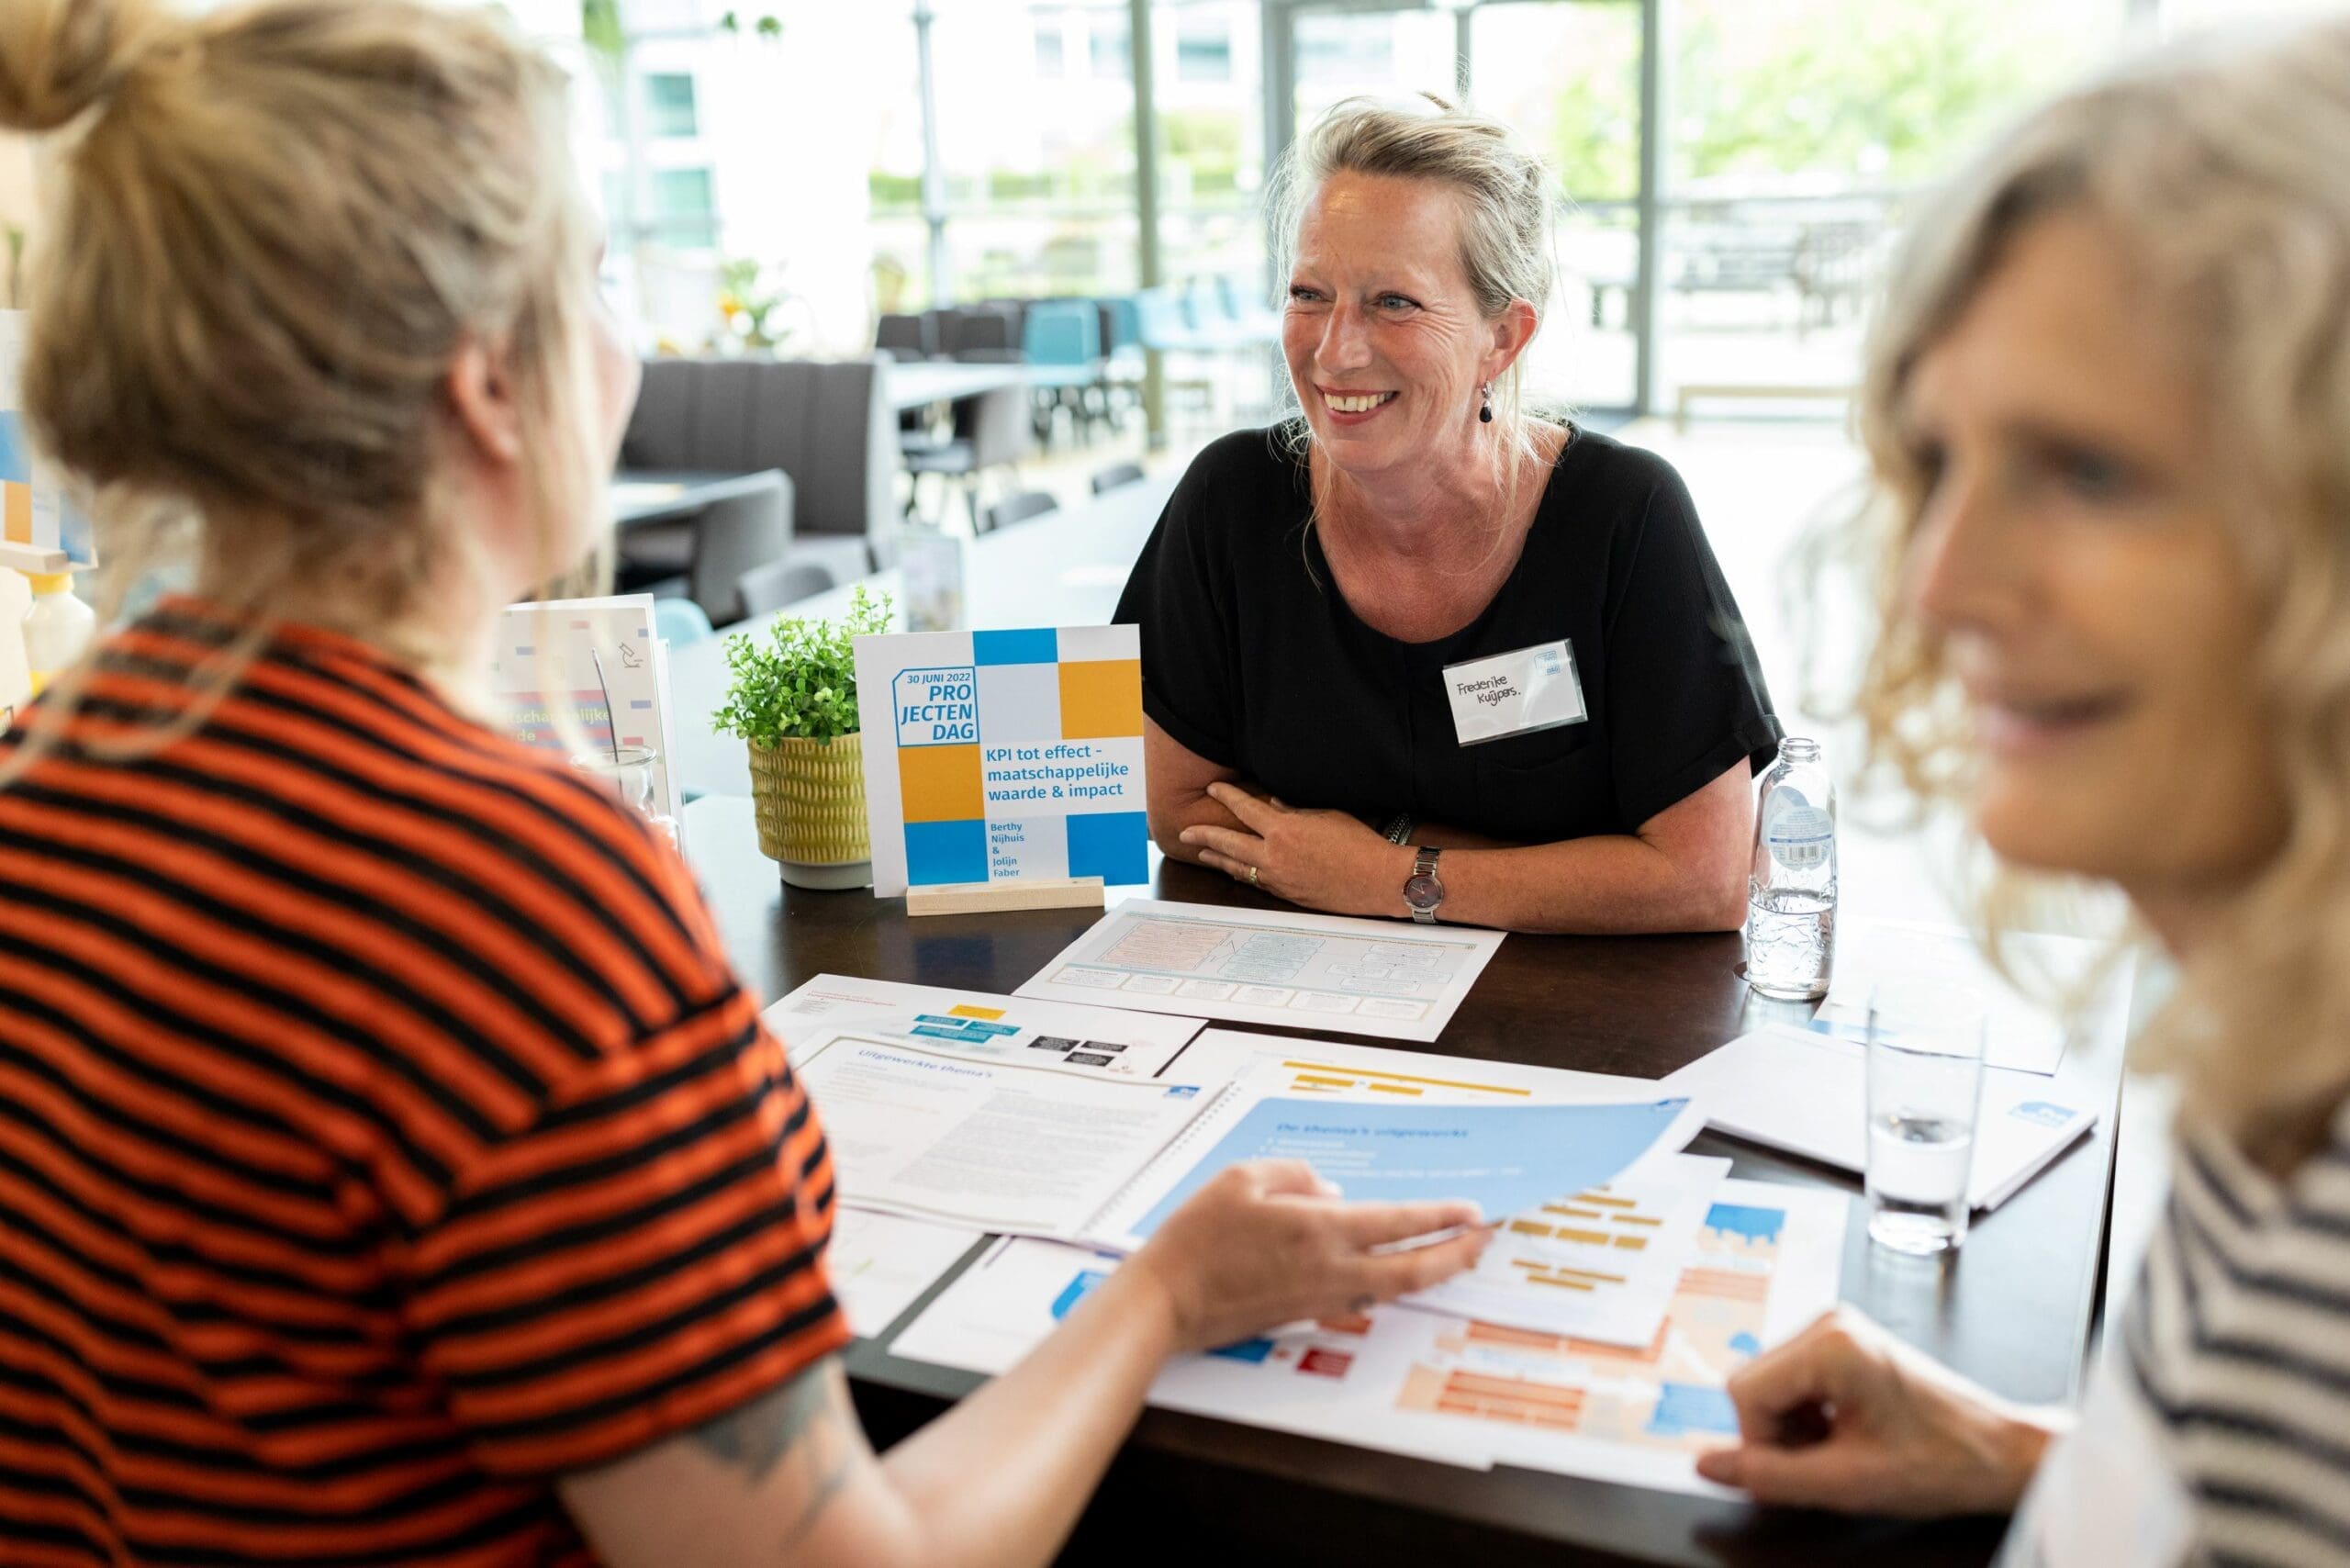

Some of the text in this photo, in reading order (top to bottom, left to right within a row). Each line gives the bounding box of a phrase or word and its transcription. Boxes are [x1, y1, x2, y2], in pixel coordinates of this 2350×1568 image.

[907, 673, 971, 685] 30 JUNI 2022
[1457, 676, 1508, 695] Frederike
[929, 684, 972, 701] PRO
[901, 704, 973, 725] JECTEN
[933, 722, 974, 741] DAG
[986, 748, 1012, 762] KPI
[1016, 747, 1040, 760] tot
[1045, 745, 1091, 759] effect
[988, 761, 1129, 781] maatschappelijke
[989, 783, 1124, 801] waarde & impact
[990, 823, 1023, 832] Berthy
[991, 833, 1025, 845] Nijhuis
[992, 846, 1000, 855] &
[992, 856, 1017, 868] Jolijn
[994, 868, 1020, 878] Faber
